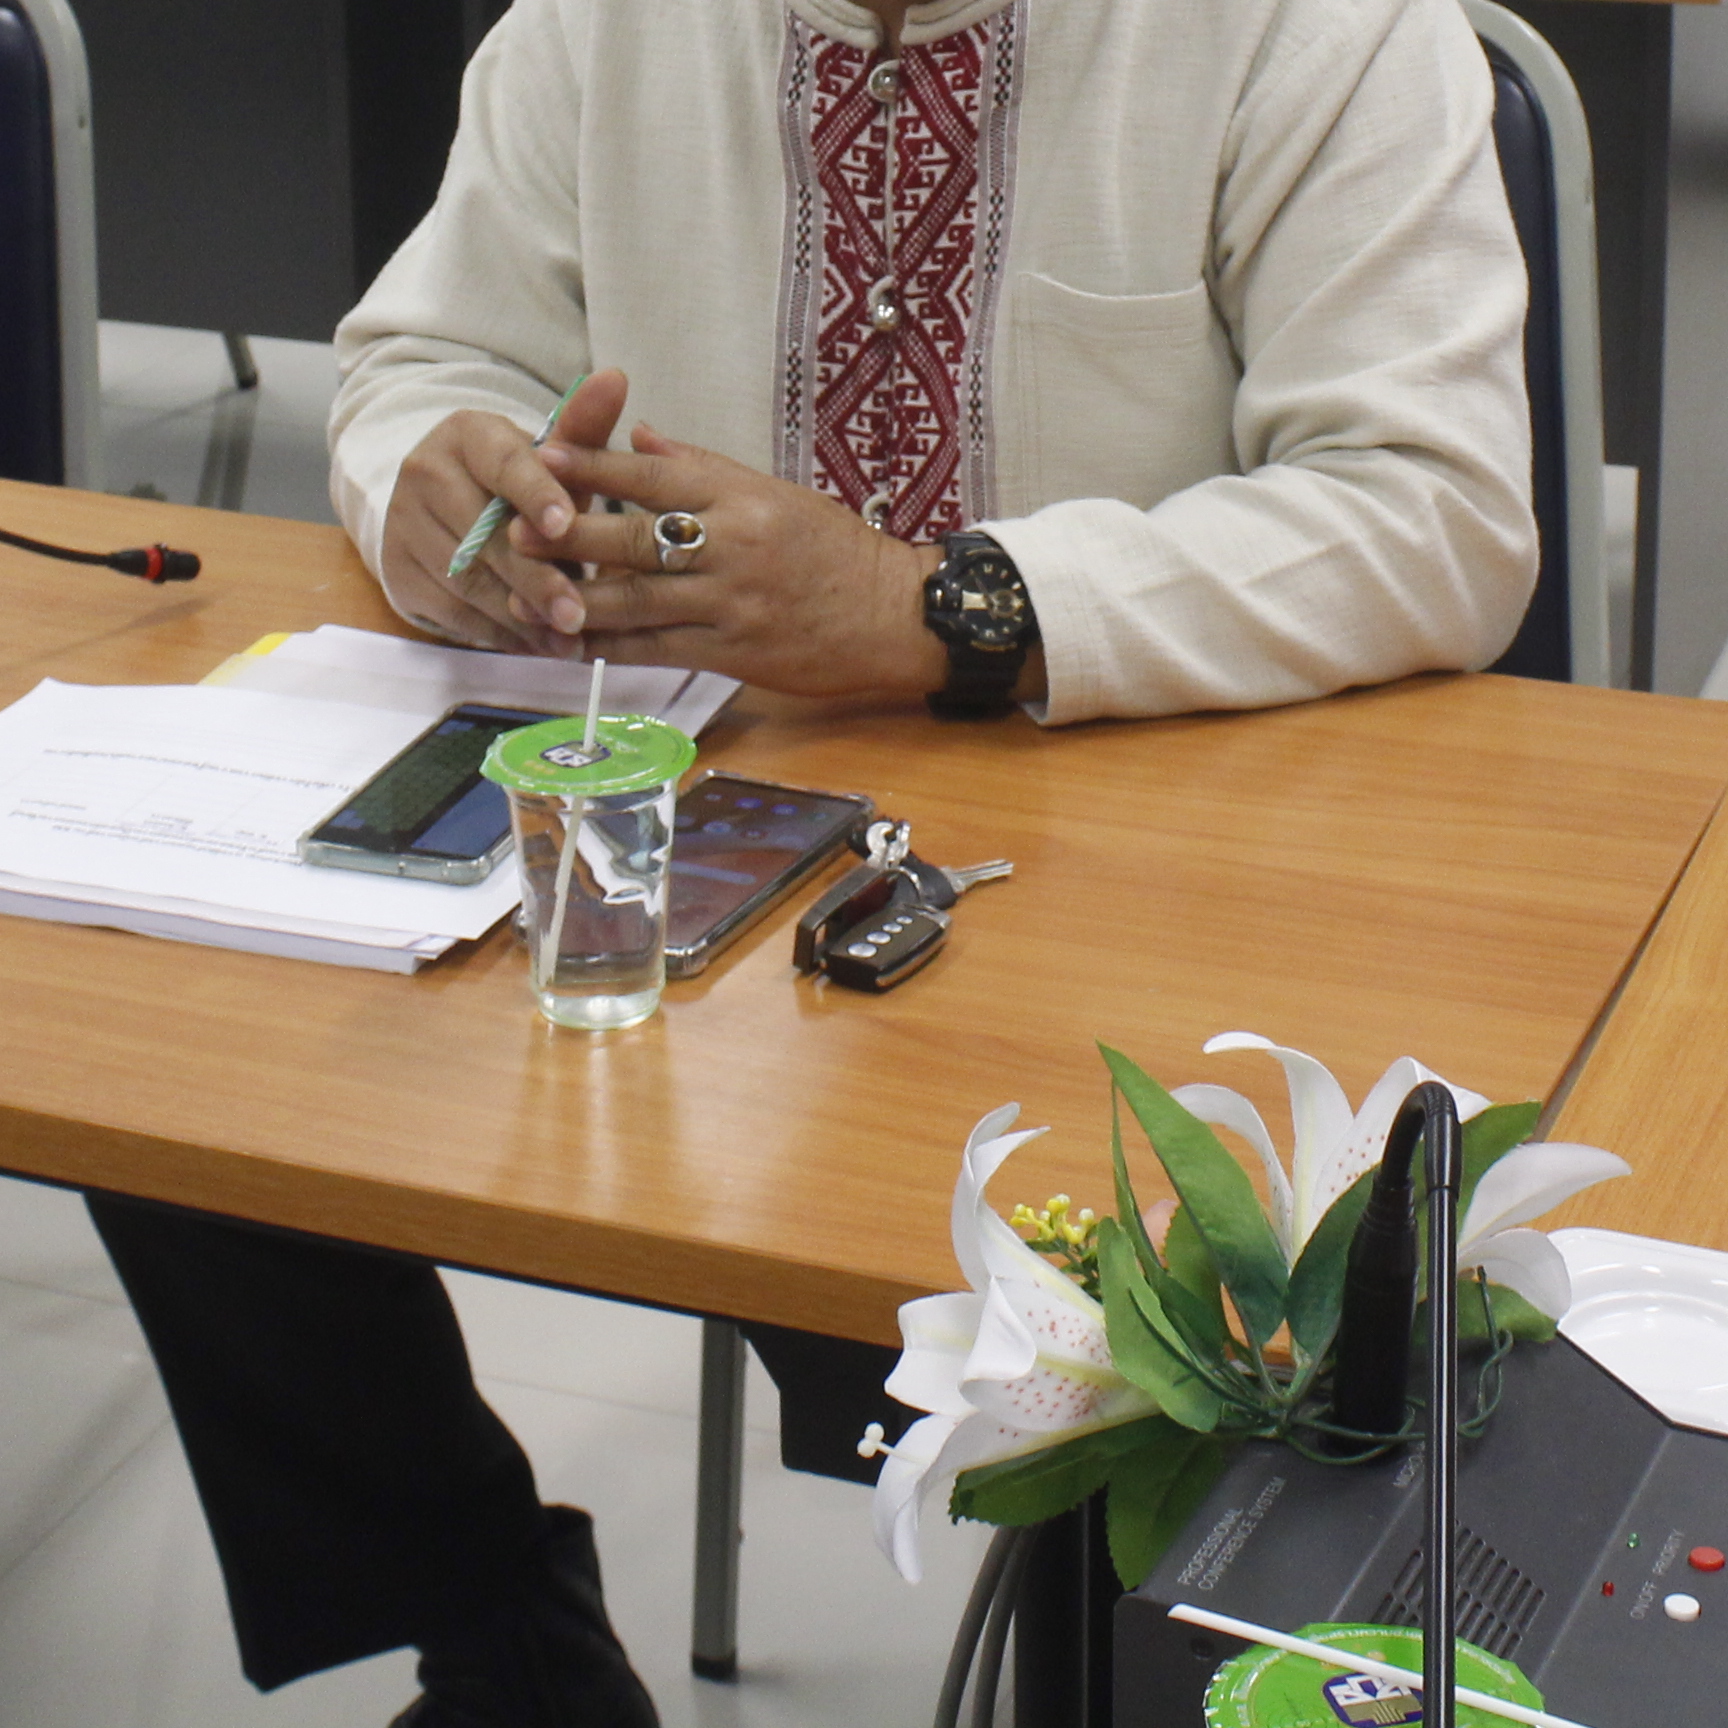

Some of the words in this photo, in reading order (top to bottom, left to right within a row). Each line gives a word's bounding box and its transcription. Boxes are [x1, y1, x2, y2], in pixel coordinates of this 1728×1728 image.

[1177, 1508, 1244, 1585] PROFESSIONAL
[1197, 1518, 1258, 1590] CONFERENCE
[1248, 1476, 1287, 1519] SYSTEM
